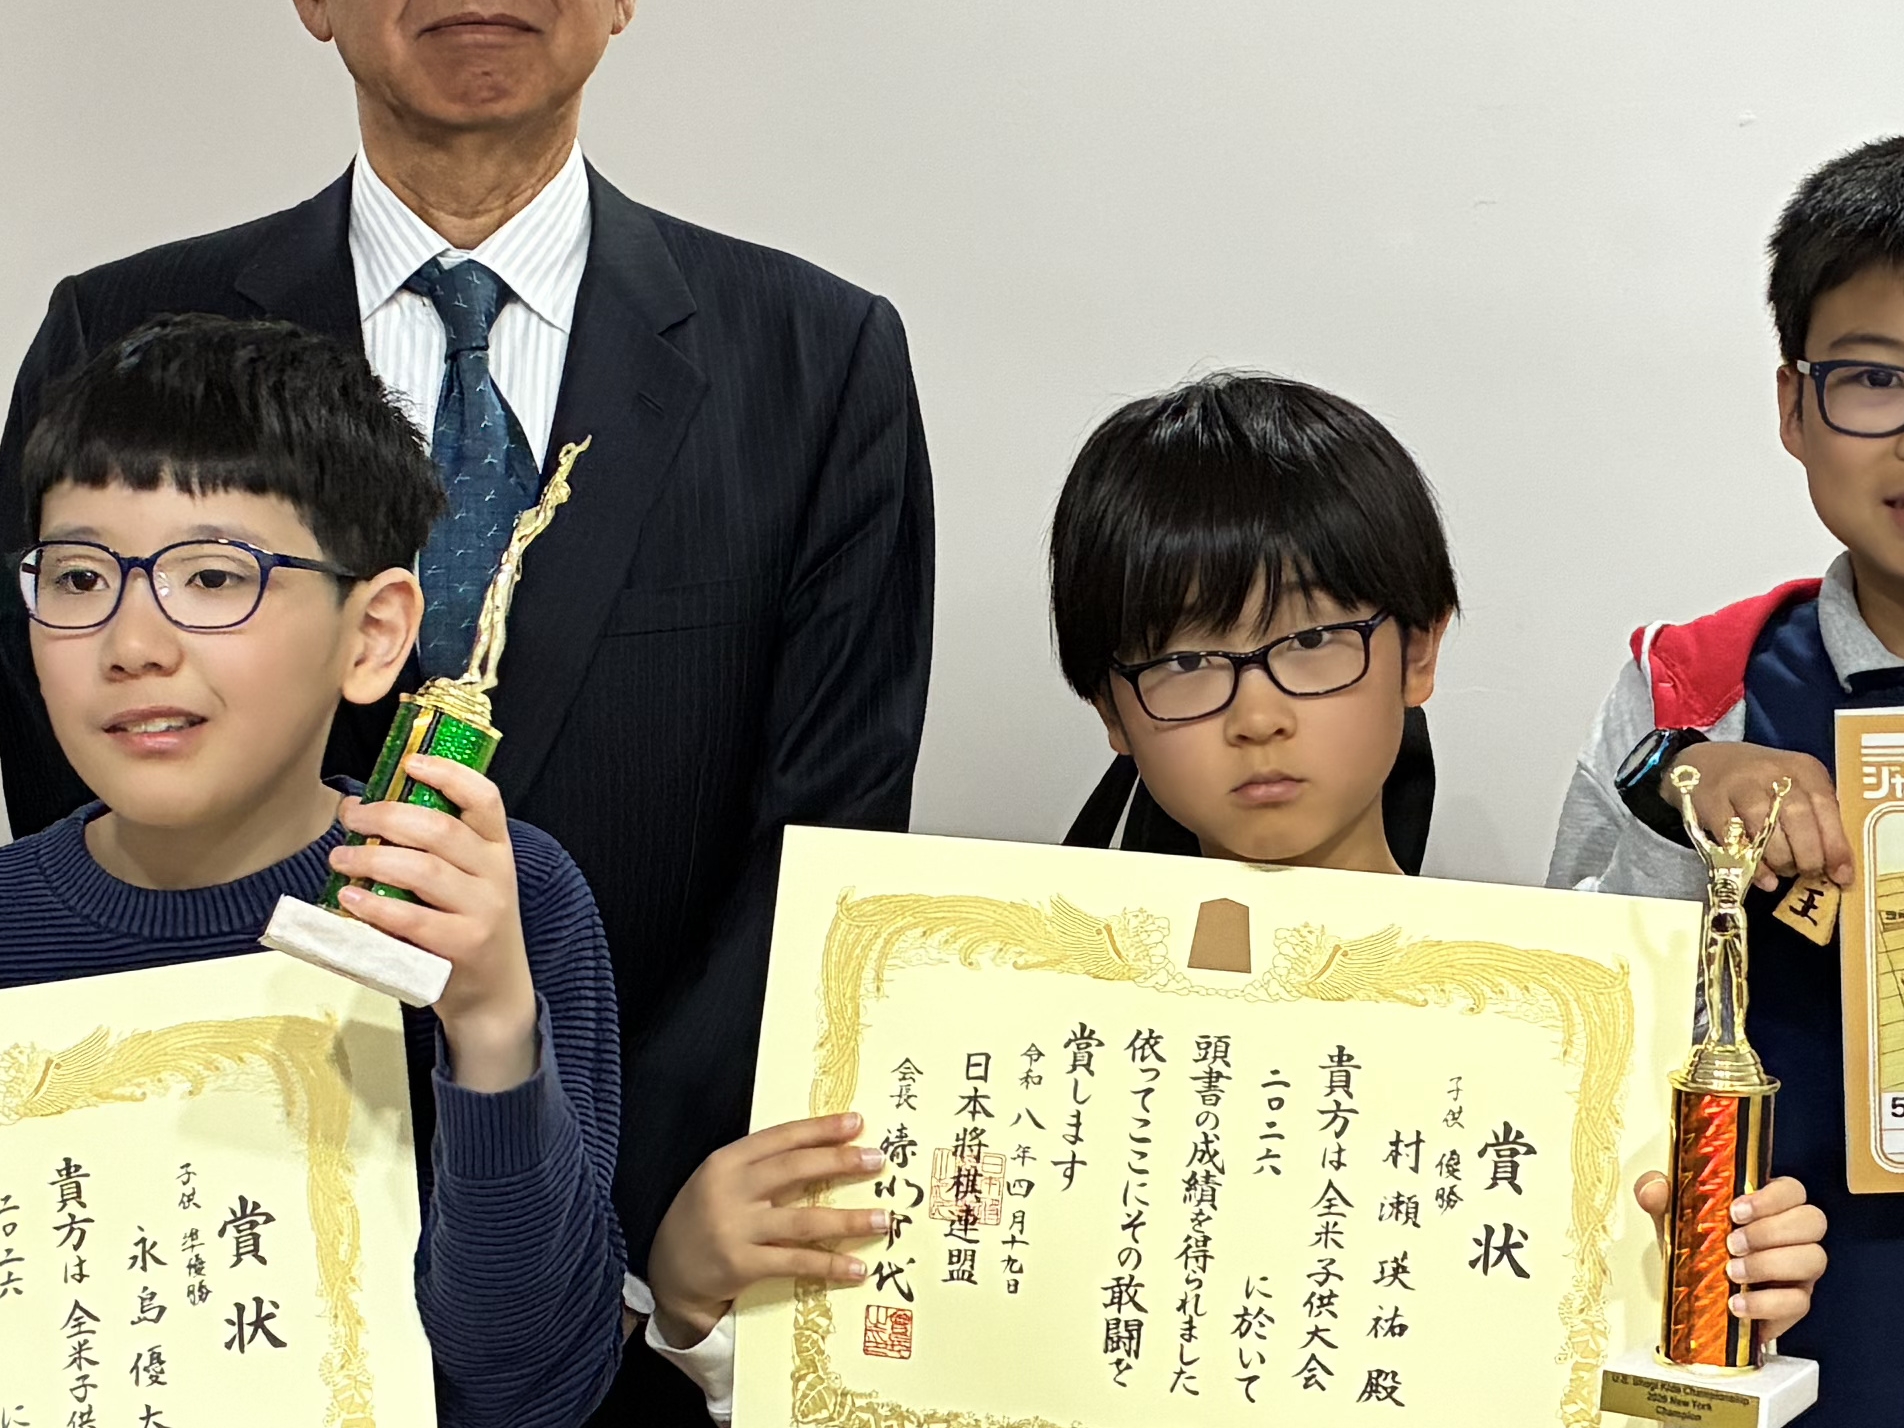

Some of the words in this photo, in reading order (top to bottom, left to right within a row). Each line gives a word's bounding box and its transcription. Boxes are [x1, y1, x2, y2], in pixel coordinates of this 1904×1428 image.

[1050, 1022, 1107, 1192] 賞します
[217, 1194, 288, 1354] 賞状
[1100, 1028, 1168, 1388] 依ってここにその敢闘を
[1169, 1034, 1234, 1396] 頭書の成績を得られました
[1468, 1121, 1538, 1280] 賞状
